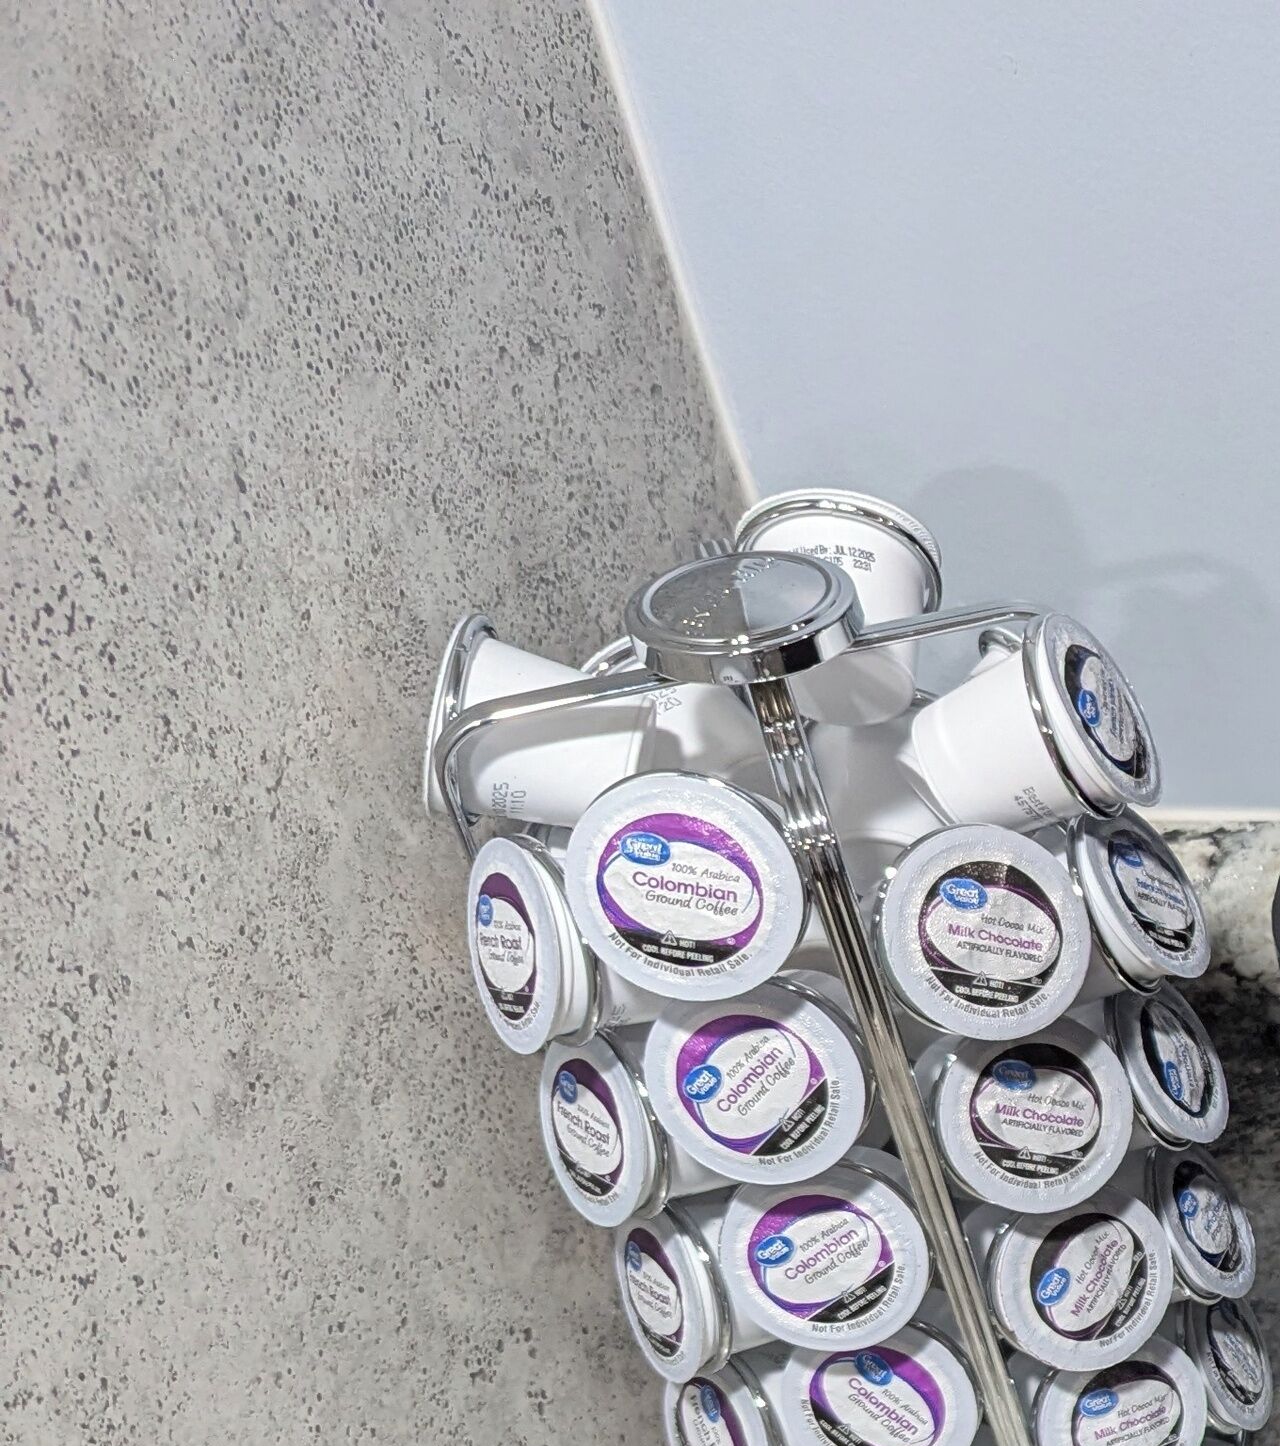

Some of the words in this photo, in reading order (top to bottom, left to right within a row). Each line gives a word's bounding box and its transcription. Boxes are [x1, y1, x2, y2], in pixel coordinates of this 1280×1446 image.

[834, 545, 848, 556] JUL
[632, 871, 737, 903] Colombian
[671, 862, 697, 875] 100%
[701, 868, 740, 883] Arabica
[645, 890, 693, 909] Ground
[696, 898, 738, 916] Coffee
[946, 883, 979, 899] Great
[948, 923, 975, 939] Milk
[978, 929, 1043, 952] Chocolate
[981, 913, 997, 926] Hot
[1027, 924, 1045, 935] Mix
[499, 936, 522, 950] Roast
[608, 932, 625, 950] Not
[625, 947, 641, 961] For
[643, 957, 695, 977] Individual
[698, 965, 727, 977] Retail
[728, 952, 752, 969] Sale.
[661, 949, 685, 960] BEFORE
[687, 952, 714, 963] PEELING
[679, 940, 696, 949] HOT!
[957, 940, 1004, 956] ARTIFICIALLY
[926, 977, 939, 993] Not
[939, 988, 954, 1004] For
[954, 1001, 1000, 1018] Individual
[1002, 1004, 1029, 1018] Retail
[1029, 992, 1050, 1008] Sale.
[726, 1061, 745, 1079] 100%
[744, 1035, 771, 1063] Arabica
[686, 1069, 714, 1096] Great
[717, 1046, 784, 1113] Colombian
[737, 1083, 770, 1117] Ground
[767, 1057, 796, 1086] Coffee
[1028, 1093, 1043, 1102] Hot
[557, 1100, 584, 1130] French
[584, 1122, 610, 1146] Roast
[995, 1103, 1019, 1118] Milk
[1022, 1108, 1084, 1127] Chocolate
[1001, 1118, 1048, 1133] ARTIFICIALLY
[1048, 1125, 1084, 1137] FLAVORED
[758, 1156, 776, 1166] Not
[777, 1153, 794, 1164] For
[795, 1125, 829, 1159] Individual
[823, 1100, 840, 1129] Retail
[973, 1151, 987, 1167] Not
[987, 1162, 1000, 1176] For
[1000, 1172, 1041, 1190] Individual
[758, 1238, 785, 1260] Great
[784, 1228, 860, 1280] Colombian
[799, 1233, 819, 1253] 100%
[804, 1255, 839, 1284] Ground
[838, 1239, 869, 1263] Coffee
[1070, 1294, 1090, 1317] Milk
[1086, 1239, 1119, 1293] Chocolate
[812, 1322, 829, 1334] Not
[829, 1324, 846, 1334] For
[848, 1308, 885, 1331] Individual
[882, 1282, 902, 1311] Retail
[1086, 1274, 1112, 1314] ARTIFICIALLY
[1126, 1298, 1153, 1333] Individual
[1149, 1272, 1159, 1298] Retail
[848, 1377, 918, 1435] Colombian
[881, 1388, 901, 1404] 100%
[1084, 1395, 1110, 1408] Great
[801, 1399, 809, 1414] Not
[805, 1413, 815, 1429] For
[848, 1393, 880, 1422] Ground
[880, 1417, 911, 1443] Coffee
[1094, 1424, 1116, 1440] Milk
[1119, 1406, 1167, 1432] Chocolate
[1117, 1409, 1129, 1419] Hot
[1106, 1430, 1145, 1446] ARTIFICIALLY
